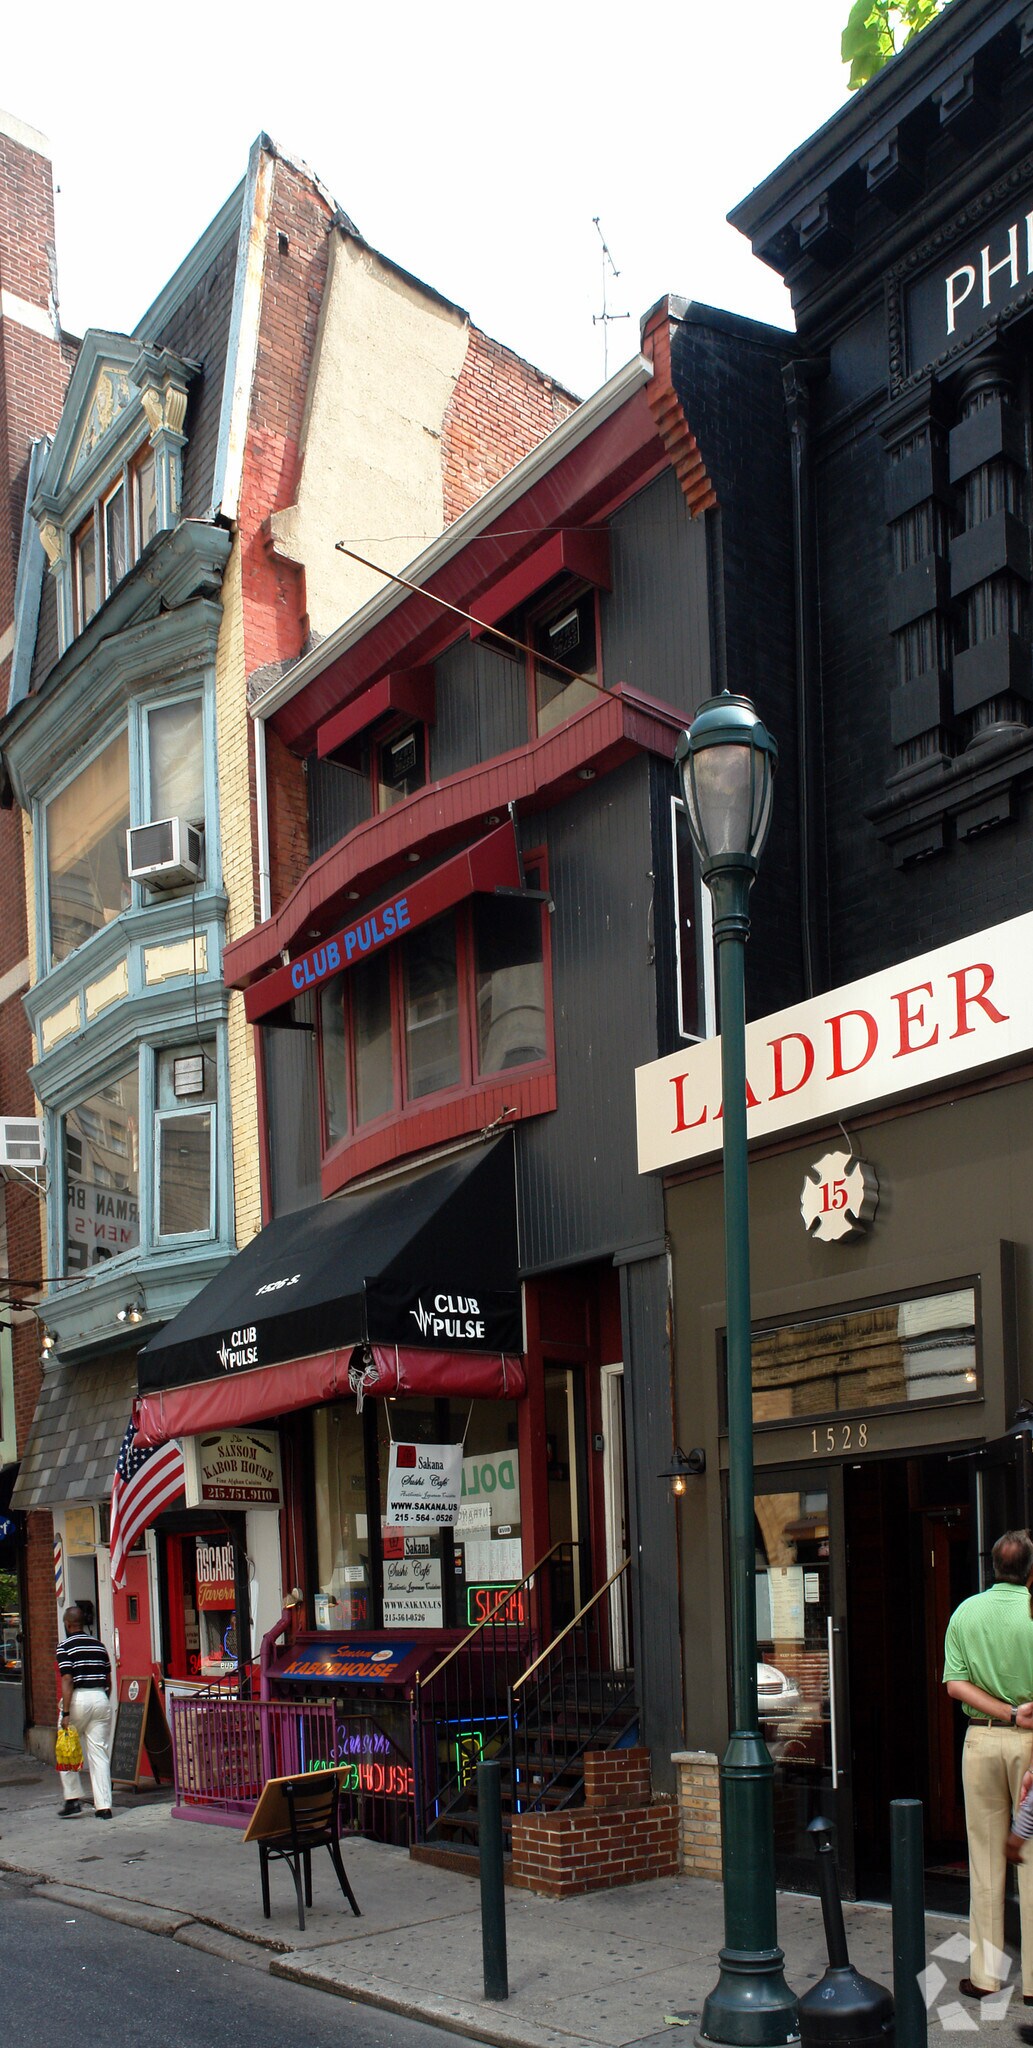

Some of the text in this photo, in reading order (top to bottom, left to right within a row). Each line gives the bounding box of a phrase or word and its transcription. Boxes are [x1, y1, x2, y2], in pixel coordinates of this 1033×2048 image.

[291, 898, 411, 990] CLUB PULSE
[819, 1179, 849, 1213] 15
[434, 1294, 481, 1315] CLUB
[231, 1326, 257, 1348] CLUB
[432, 1318, 485, 1339] PULSE
[229, 1346, 258, 1368] PULSE
[811, 1423, 869, 1454] 1528
[217, 1444, 258, 1460] SANSOM
[203, 1460, 274, 1483] KABOB HOUSE
[418, 1456, 444, 1470] Sakana
[227, 1478, 244, 1486] Afghan
[401, 1474, 450, 1489] Sushi Café
[208, 1487, 272, 1500] 215.751.9110
[390, 1501, 458, 1511] WWW.SAKANA.US
[394, 1513, 409, 1522] 215
[415, 1513, 430, 1522] 564
[435, 1513, 453, 1522] 0526
[405, 1538, 430, 1555] Sakana
[196, 1542, 235, 1582] OSCAR'S
[387, 1562, 408, 1580] Sushi
[411, 1559, 432, 1581] Café
[198, 1583, 235, 1606] Tavern
[384, 1601, 442, 1610] WWW.SAKANA.US
[384, 1613, 426, 1622] 215-564-0526
[329, 1645, 375, 1659] Sansom
[284, 1661, 399, 1678] KABOBHOUSE
